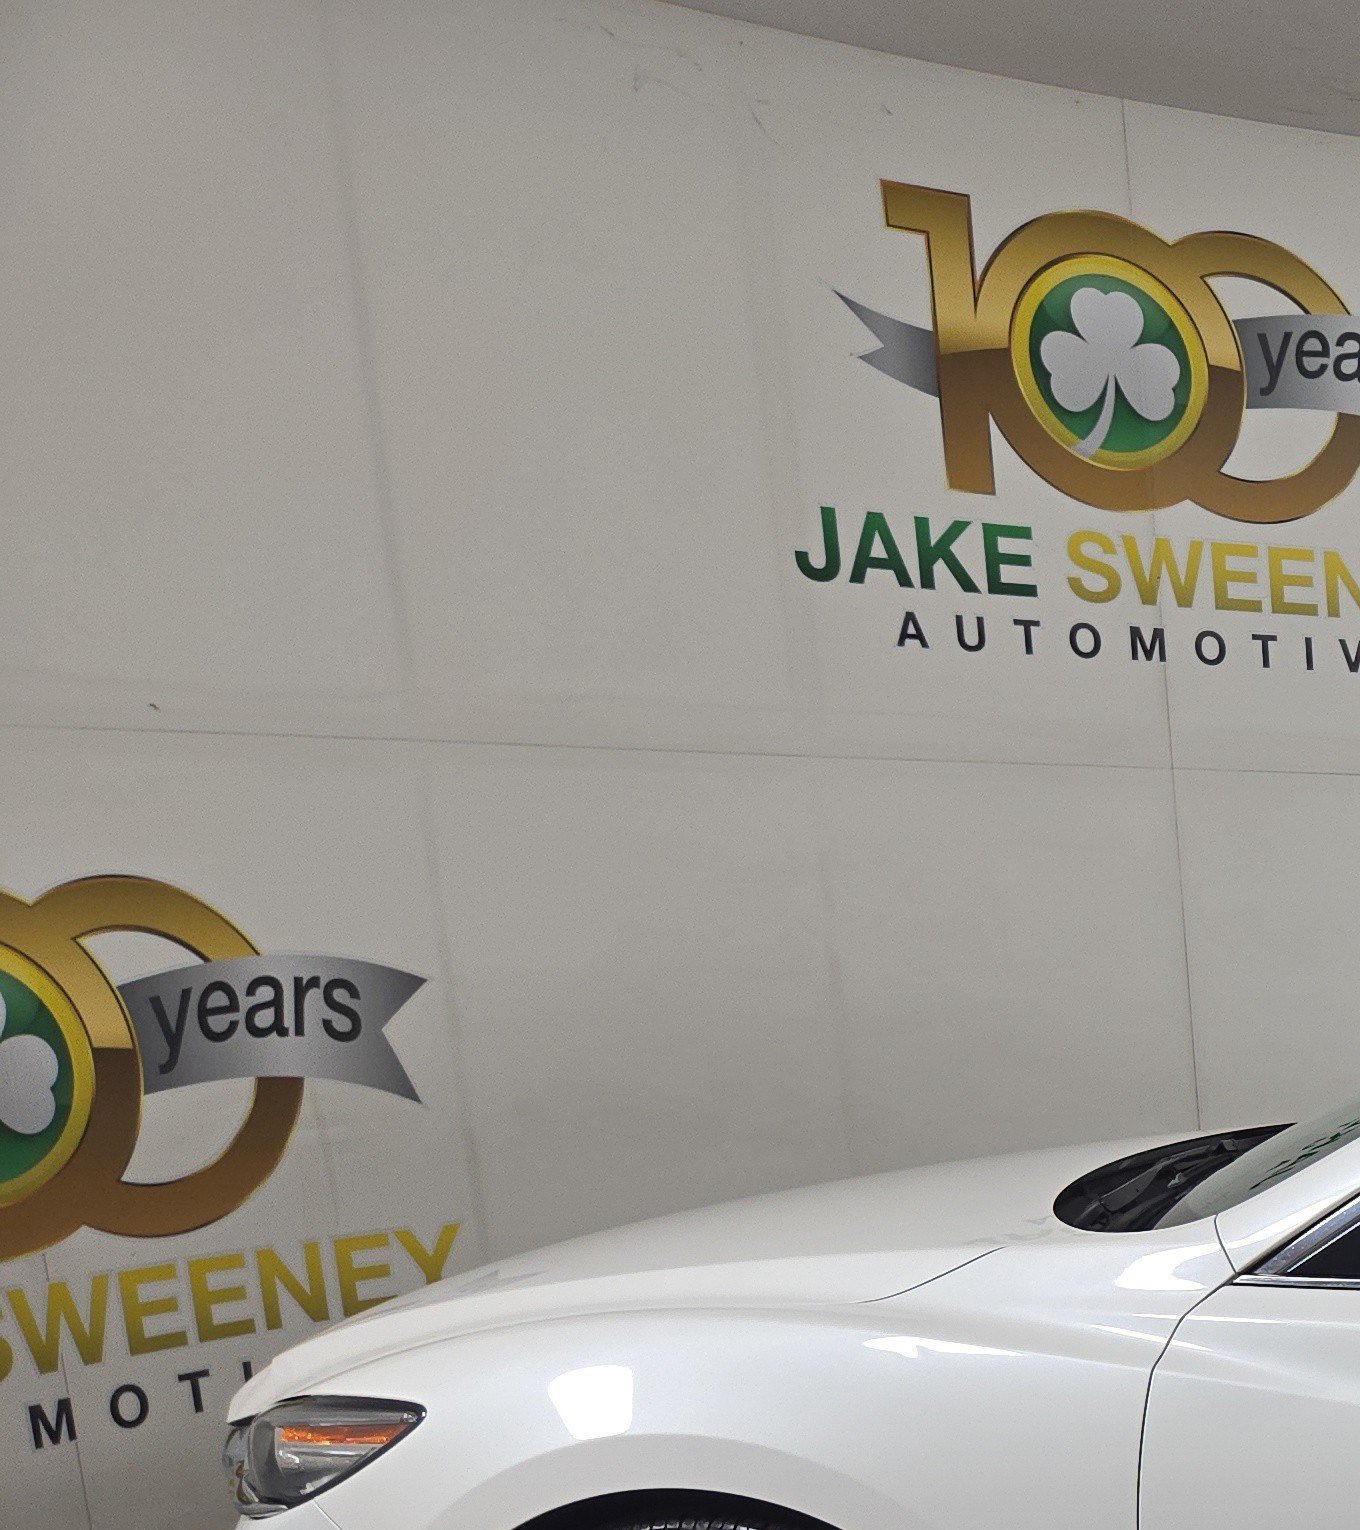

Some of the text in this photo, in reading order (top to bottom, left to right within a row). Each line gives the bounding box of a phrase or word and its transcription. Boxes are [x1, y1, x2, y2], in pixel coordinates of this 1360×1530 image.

[794, 505, 1038, 598] JAKE
[149, 974, 362, 1074] years
[0, 1223, 461, 1384] WEENEY
